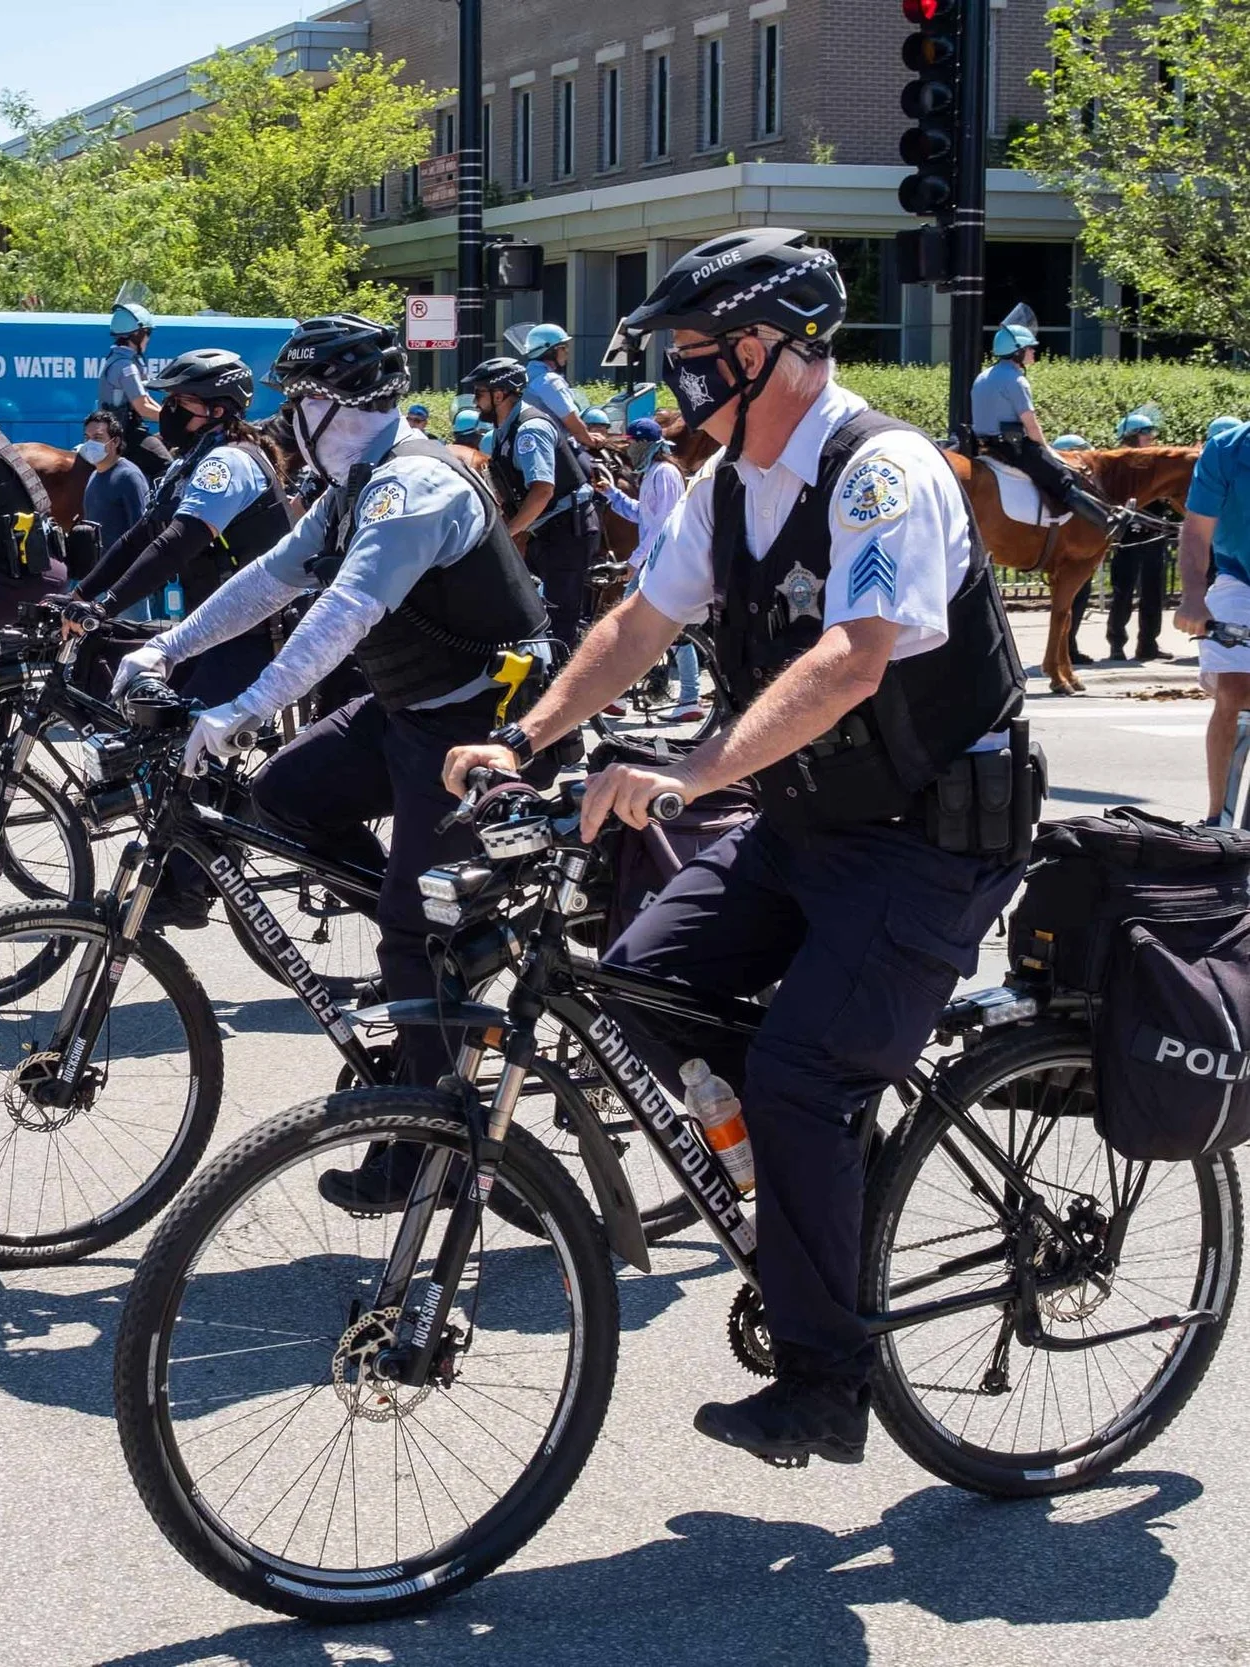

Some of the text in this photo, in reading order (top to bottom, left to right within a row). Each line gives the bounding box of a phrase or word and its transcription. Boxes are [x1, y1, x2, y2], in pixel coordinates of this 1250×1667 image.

[691, 250, 742, 285] POLICE
[14, 356, 76, 378] WATER
[287, 347, 315, 360] POLICE
[196, 477, 222, 490] POLICE
[199, 461, 228, 479] CHICAGO
[843, 464, 899, 499] CHICAGO
[849, 495, 899, 521] POLICE
[209, 854, 339, 1024] CHICAGO POLICE
[62, 1037, 87, 1083] ROCKSHOX
[1155, 1036, 1250, 1080] POLI
[588, 1013, 675, 1131] CHICAGO
[669, 1130, 744, 1232] POLICE
[411, 1282, 444, 1348] ROCKSHOX
